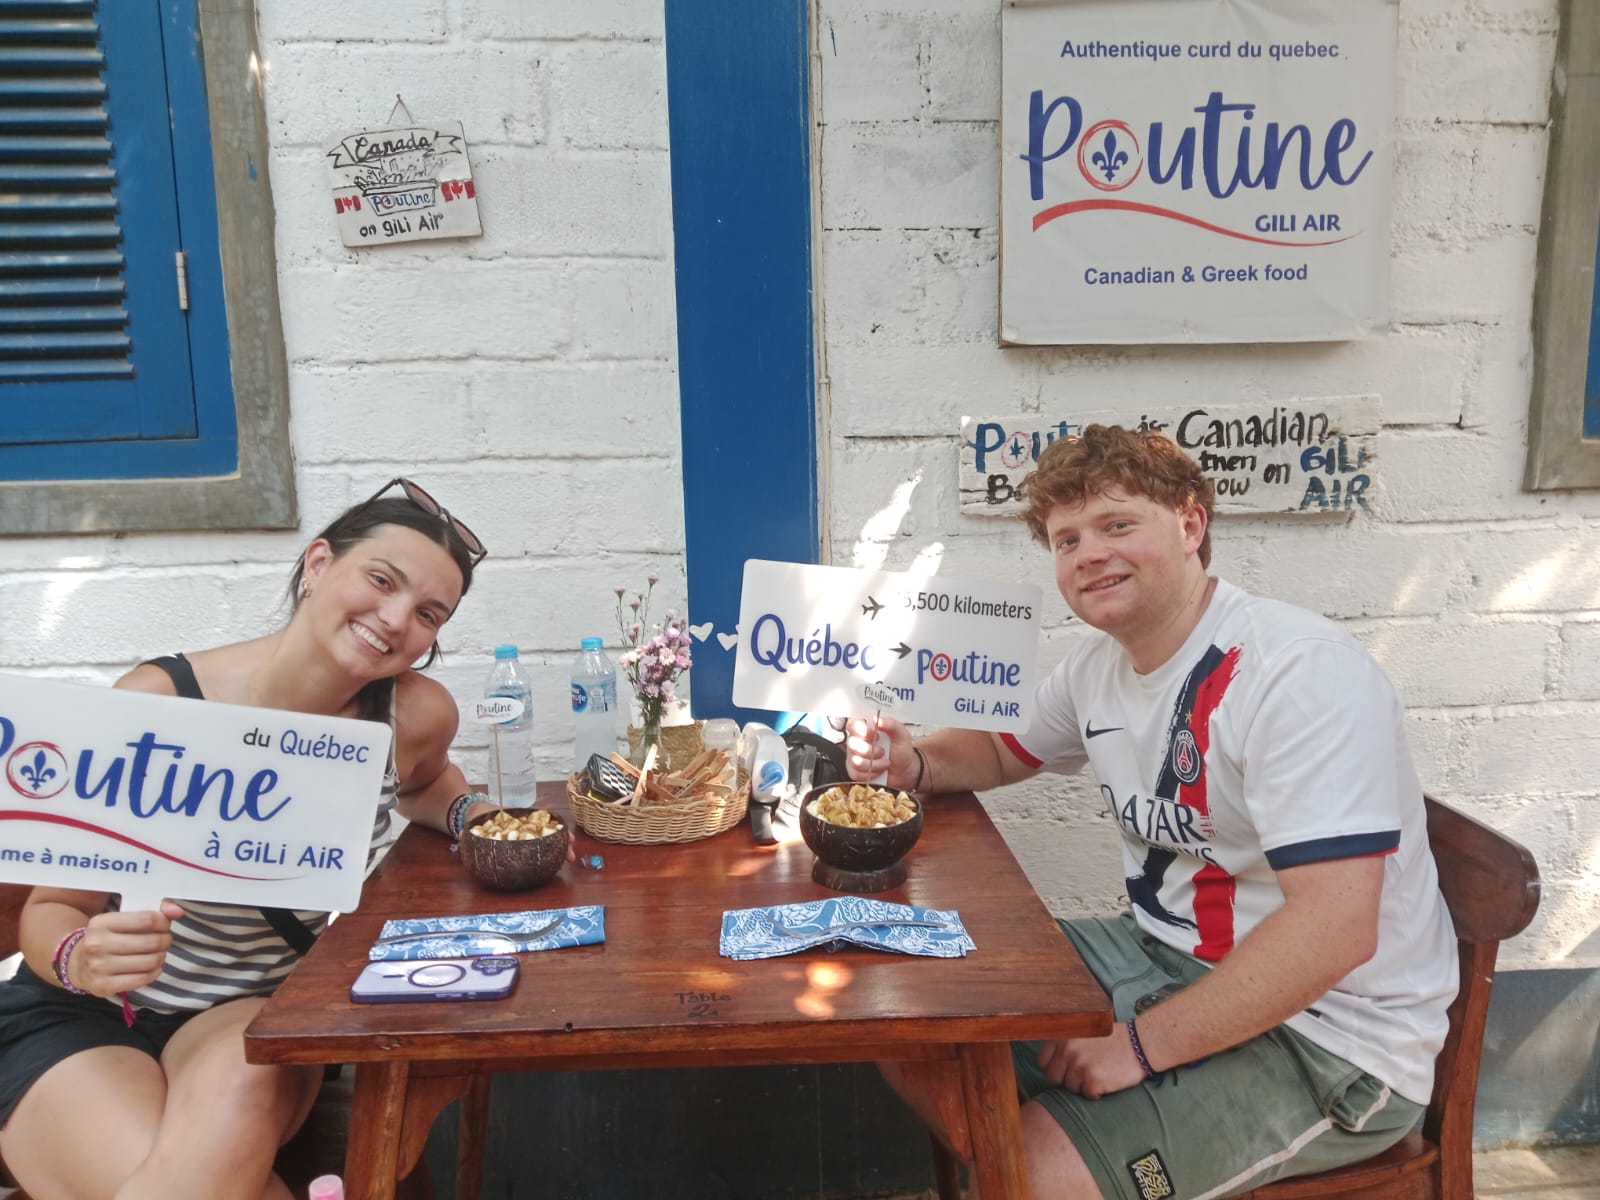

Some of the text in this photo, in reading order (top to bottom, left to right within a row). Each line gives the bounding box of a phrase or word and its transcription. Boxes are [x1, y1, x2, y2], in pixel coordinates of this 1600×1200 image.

[1060, 39, 1340, 62] Authentique curd du quebec
[355, 131, 433, 163] Canada
[1019, 89, 1373, 200] Poutine
[360, 224, 377, 237] on
[1255, 213, 1342, 233] GILI AIR
[1084, 263, 1308, 285] Canadian & Greek food
[1176, 407, 1329, 448] Canadian
[1199, 450, 1257, 472] then
[1263, 463, 1291, 485] on
[1298, 476, 1371, 512] AIR
[953, 594, 1033, 620] kilometers
[750, 613, 877, 673] Québec
[917, 648, 1022, 687] Poutine
[243, 727, 370, 763] du Québec
[40, 848, 53, 864] à
[58, 853, 138, 873] maison
[204, 831, 220, 859] à
